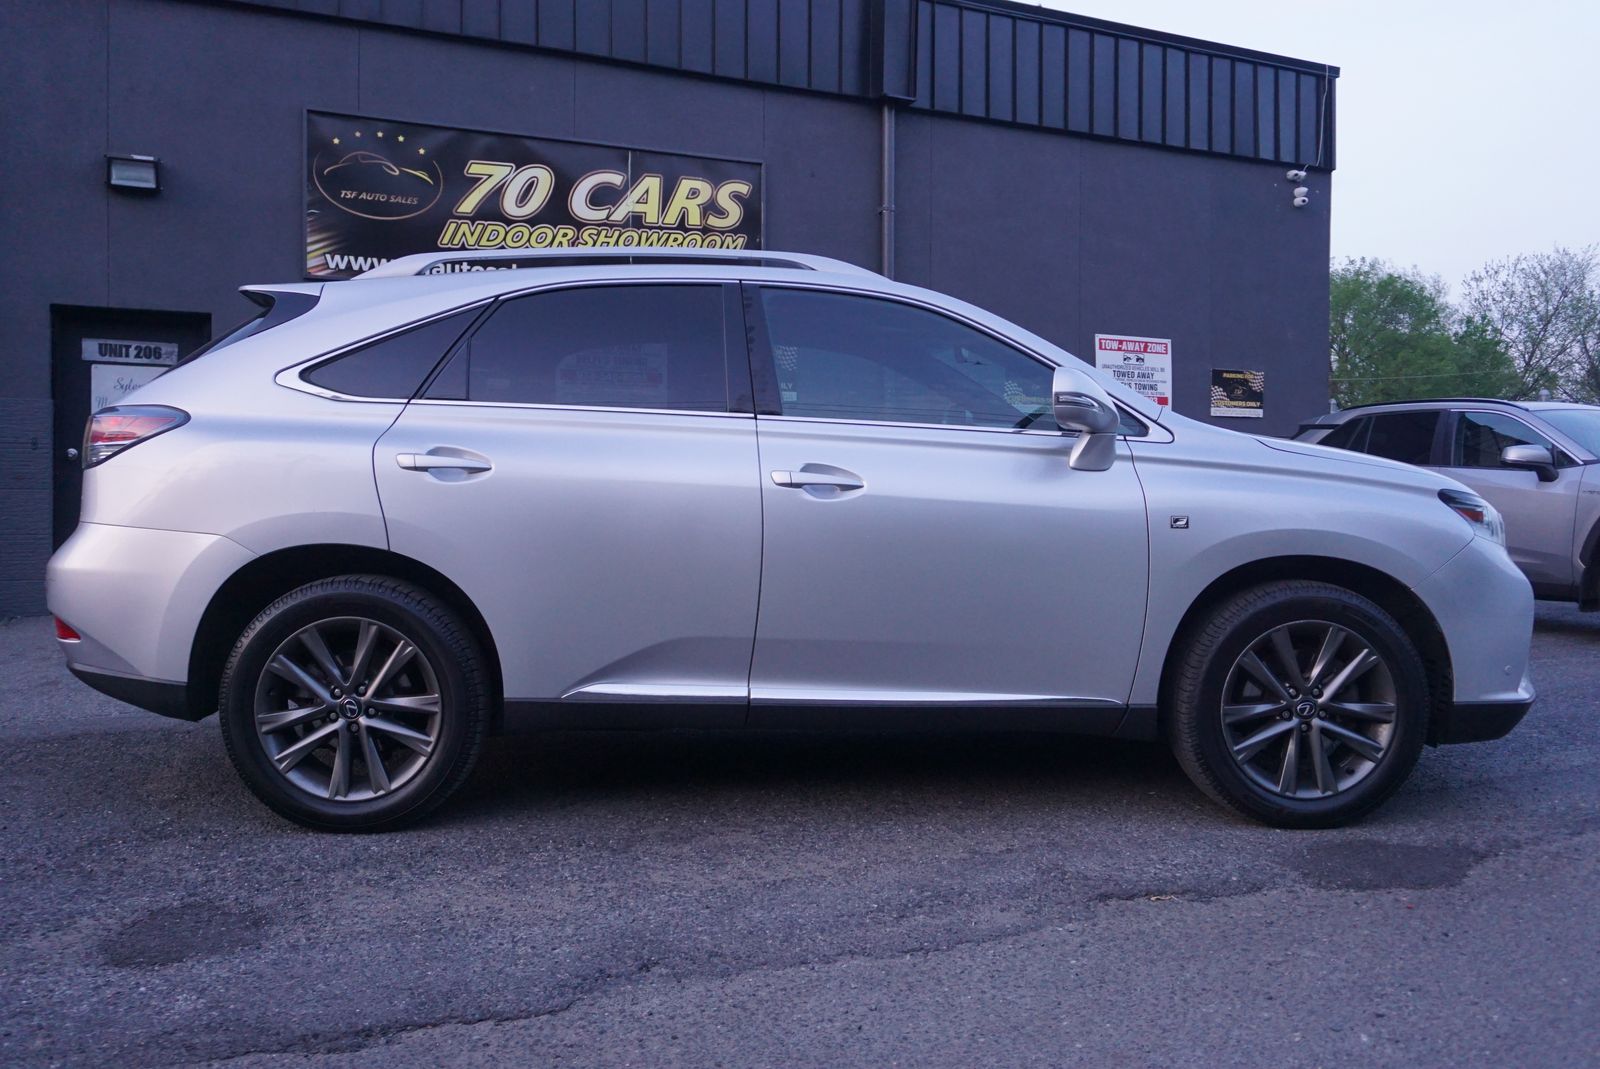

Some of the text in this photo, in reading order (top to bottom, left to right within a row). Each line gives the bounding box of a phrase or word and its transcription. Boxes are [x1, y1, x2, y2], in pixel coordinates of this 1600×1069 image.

[340, 190, 419, 205] TSF AUTO SALES
[453, 160, 752, 230] 70 CARS
[437, 219, 747, 250] INDOOR SHOWROOM
[98, 343, 162, 360] UNIT 206
[1101, 339, 1167, 353] TOW-AWAY ZONE
[1113, 370, 1135, 378] TOWED
[1134, 383, 1158, 391] TOWING
